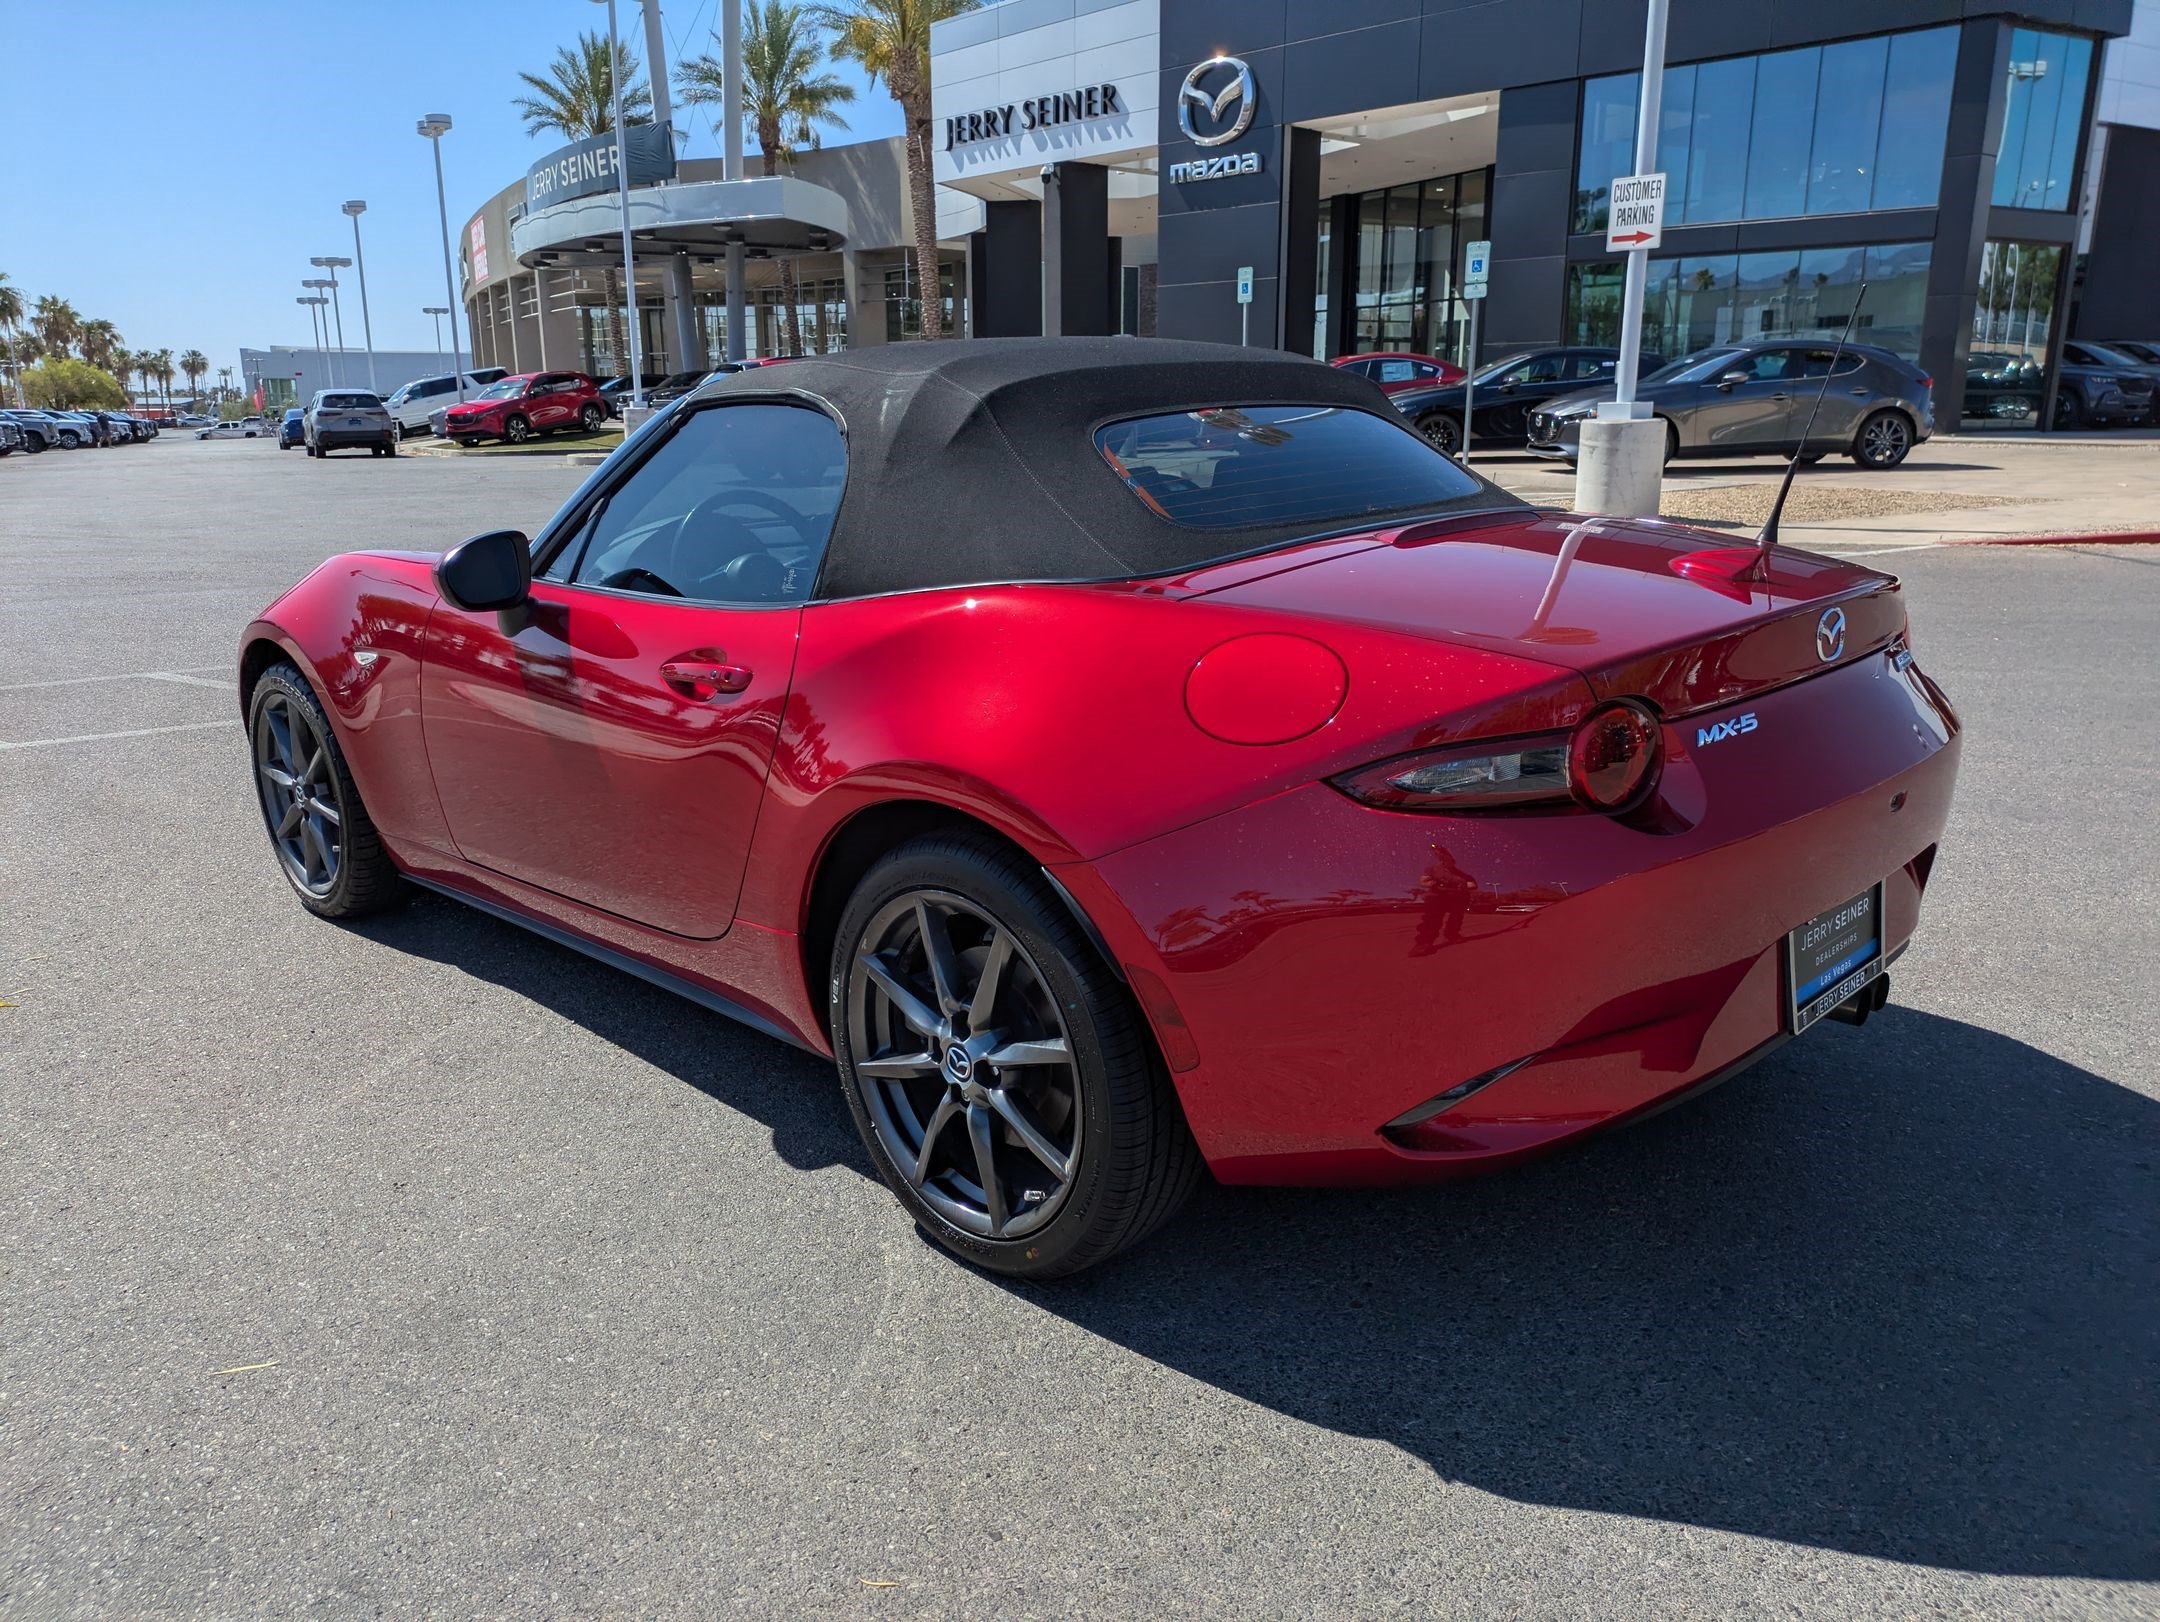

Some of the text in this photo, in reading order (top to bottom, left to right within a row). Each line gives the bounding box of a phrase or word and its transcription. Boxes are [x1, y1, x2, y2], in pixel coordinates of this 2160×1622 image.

[946, 84, 1120, 151] JERRY SEINER
[532, 145, 621, 200] JERRY SEINER
[1169, 152, 1264, 185] mazda
[1613, 179, 1662, 203] CUSTOMER
[1616, 205, 1655, 227] PARKING
[1697, 711, 1759, 747] MX-5
[1801, 897, 1869, 951] JERRY SEINER
[1815, 932, 1858, 966] DEALERSHIPS
[1820, 959, 1852, 986] Las Vegas
[1815, 972, 1866, 1017] JERRY SEINER
